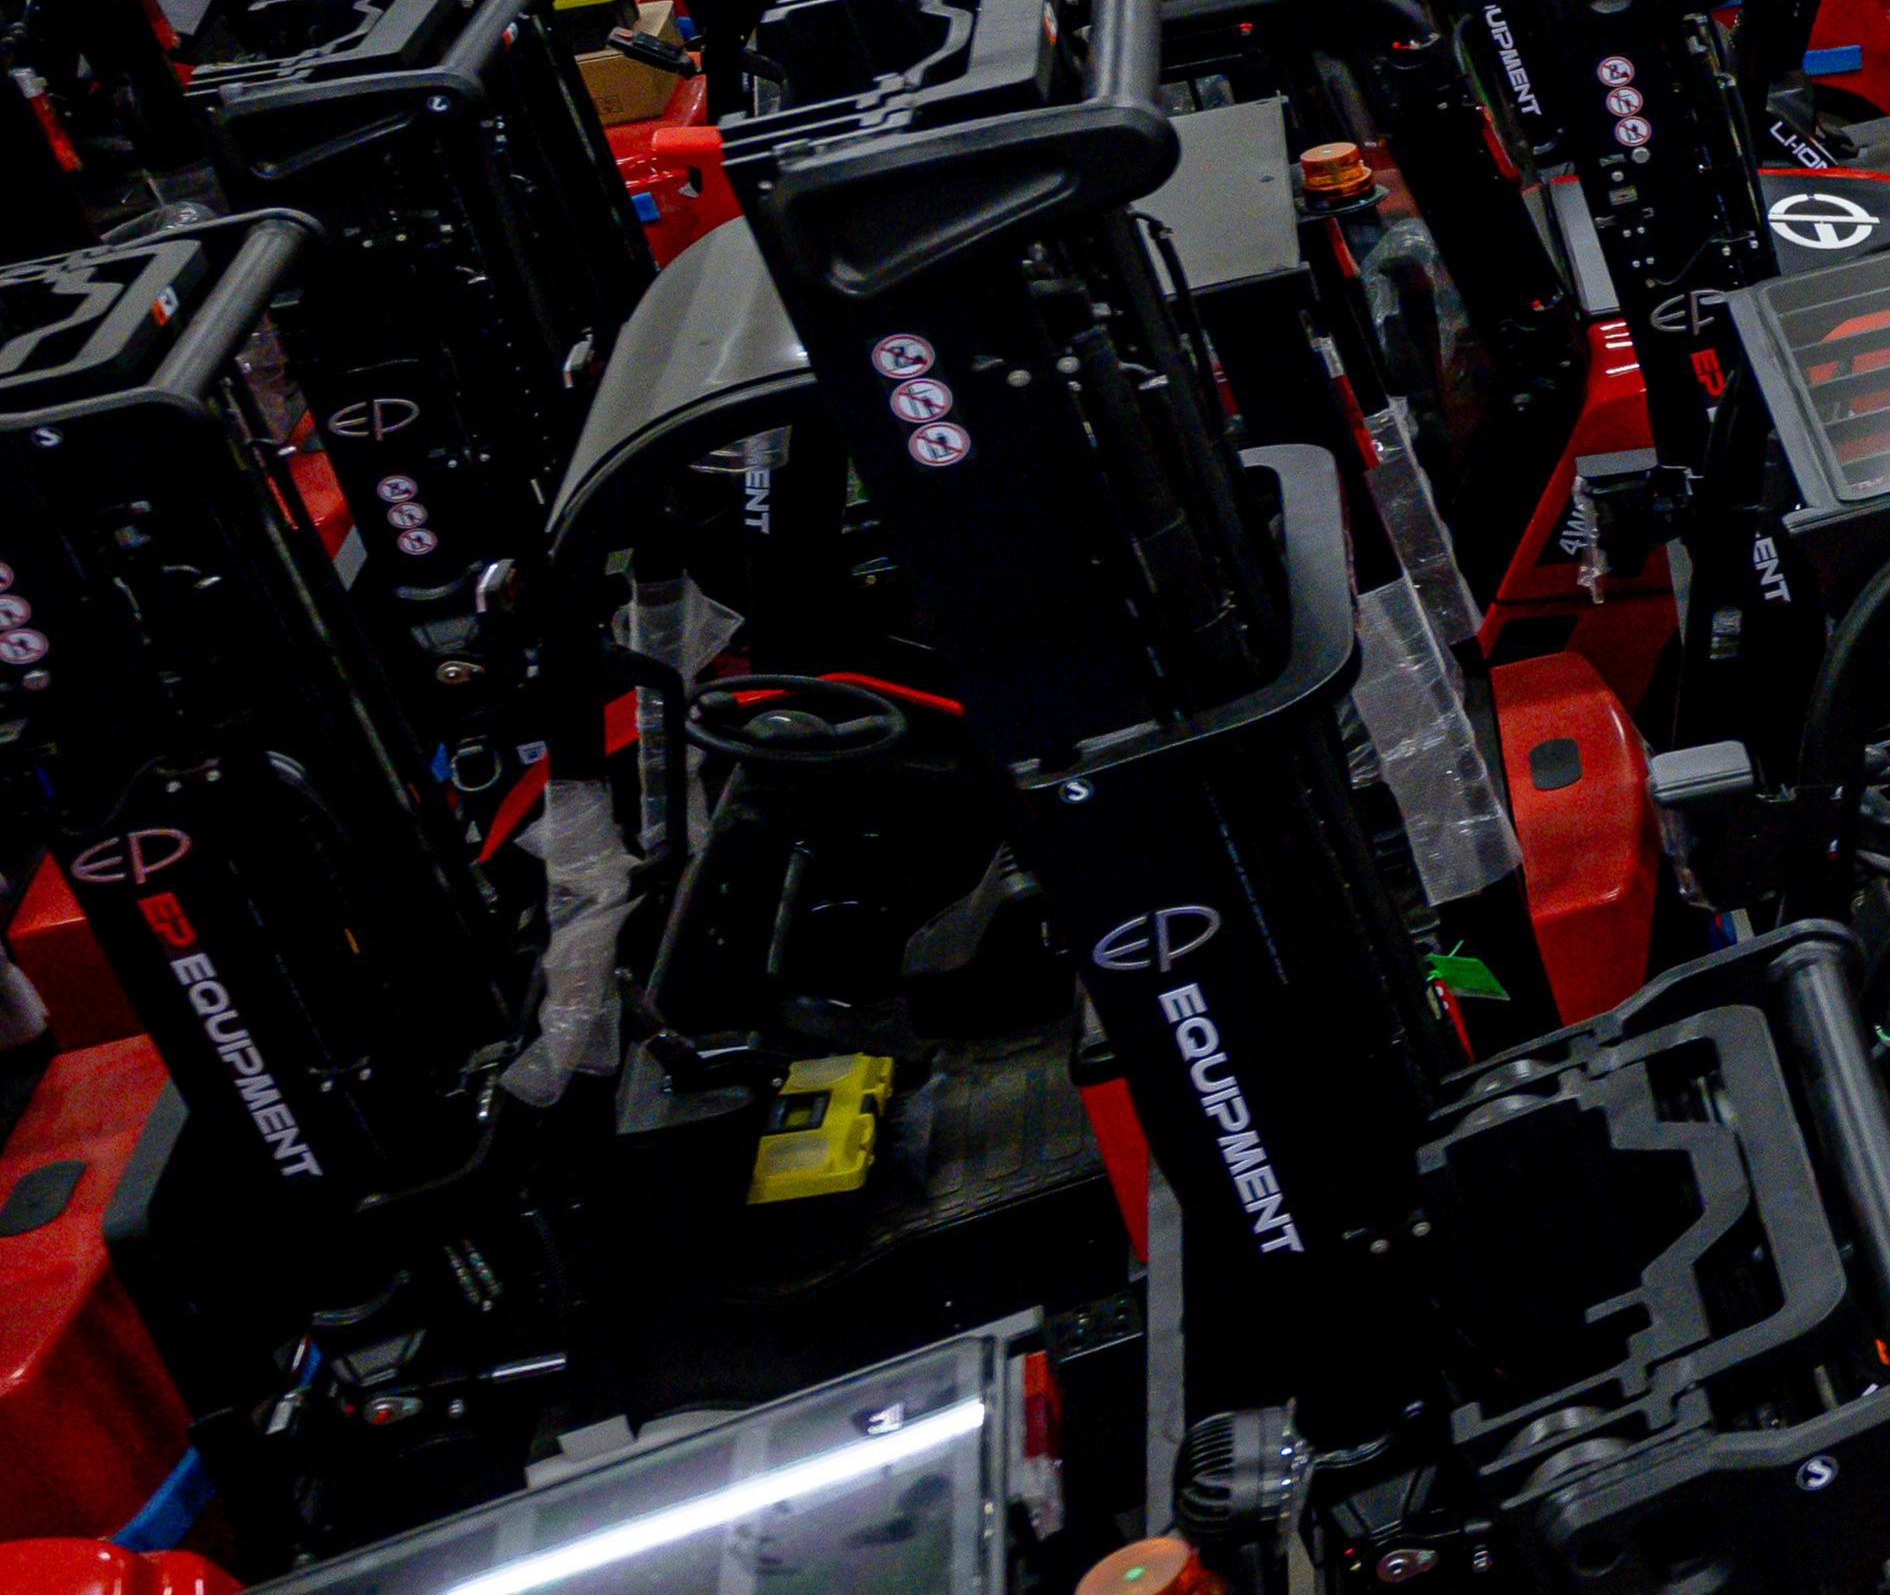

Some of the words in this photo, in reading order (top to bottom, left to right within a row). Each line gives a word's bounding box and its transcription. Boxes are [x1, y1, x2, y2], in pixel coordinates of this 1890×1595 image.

[1484, 4, 1543, 117] UIPMENT
[330, 398, 421, 442] EP
[72, 829, 192, 885] EP
[1092, 904, 1222, 973] EP
[137, 891, 198, 948] EP
[170, 951, 325, 1181] EQUIPMENT
[1157, 981, 1305, 1254] EQUIPMENT
